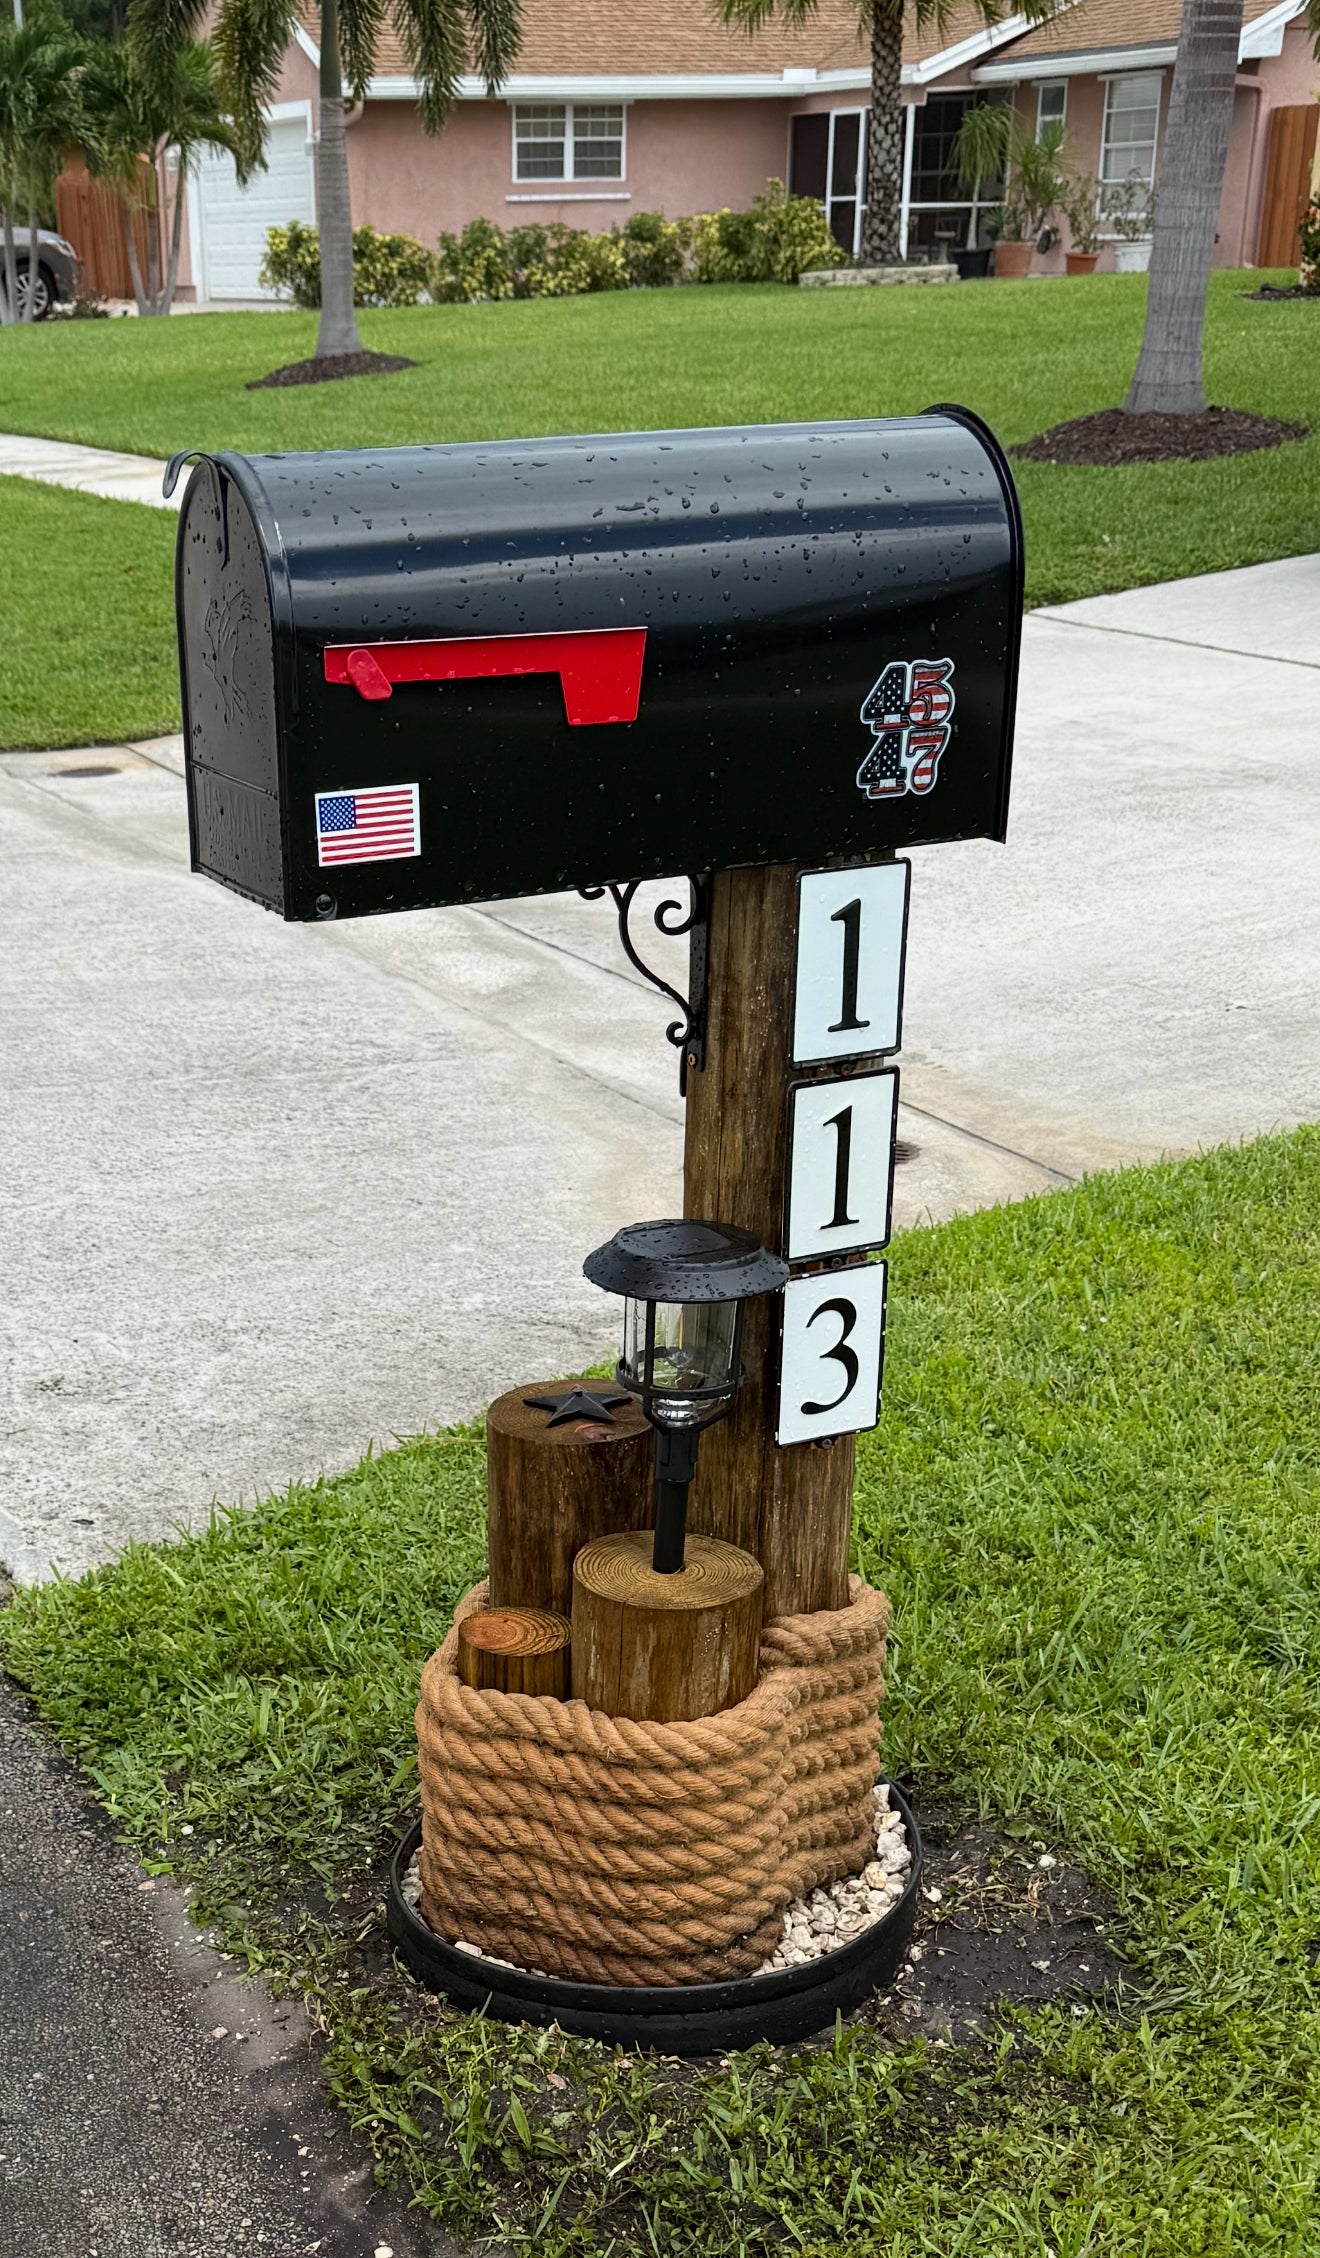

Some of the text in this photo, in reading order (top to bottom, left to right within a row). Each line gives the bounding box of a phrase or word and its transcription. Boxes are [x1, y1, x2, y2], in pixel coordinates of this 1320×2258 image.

[861, 659, 954, 732] 45
[857, 727, 950, 798] 47
[226, 790, 265, 843] MAIL
[828, 899, 870, 1032] 1
[820, 1106, 859, 1229] 1
[801, 1298, 858, 1414] 3
